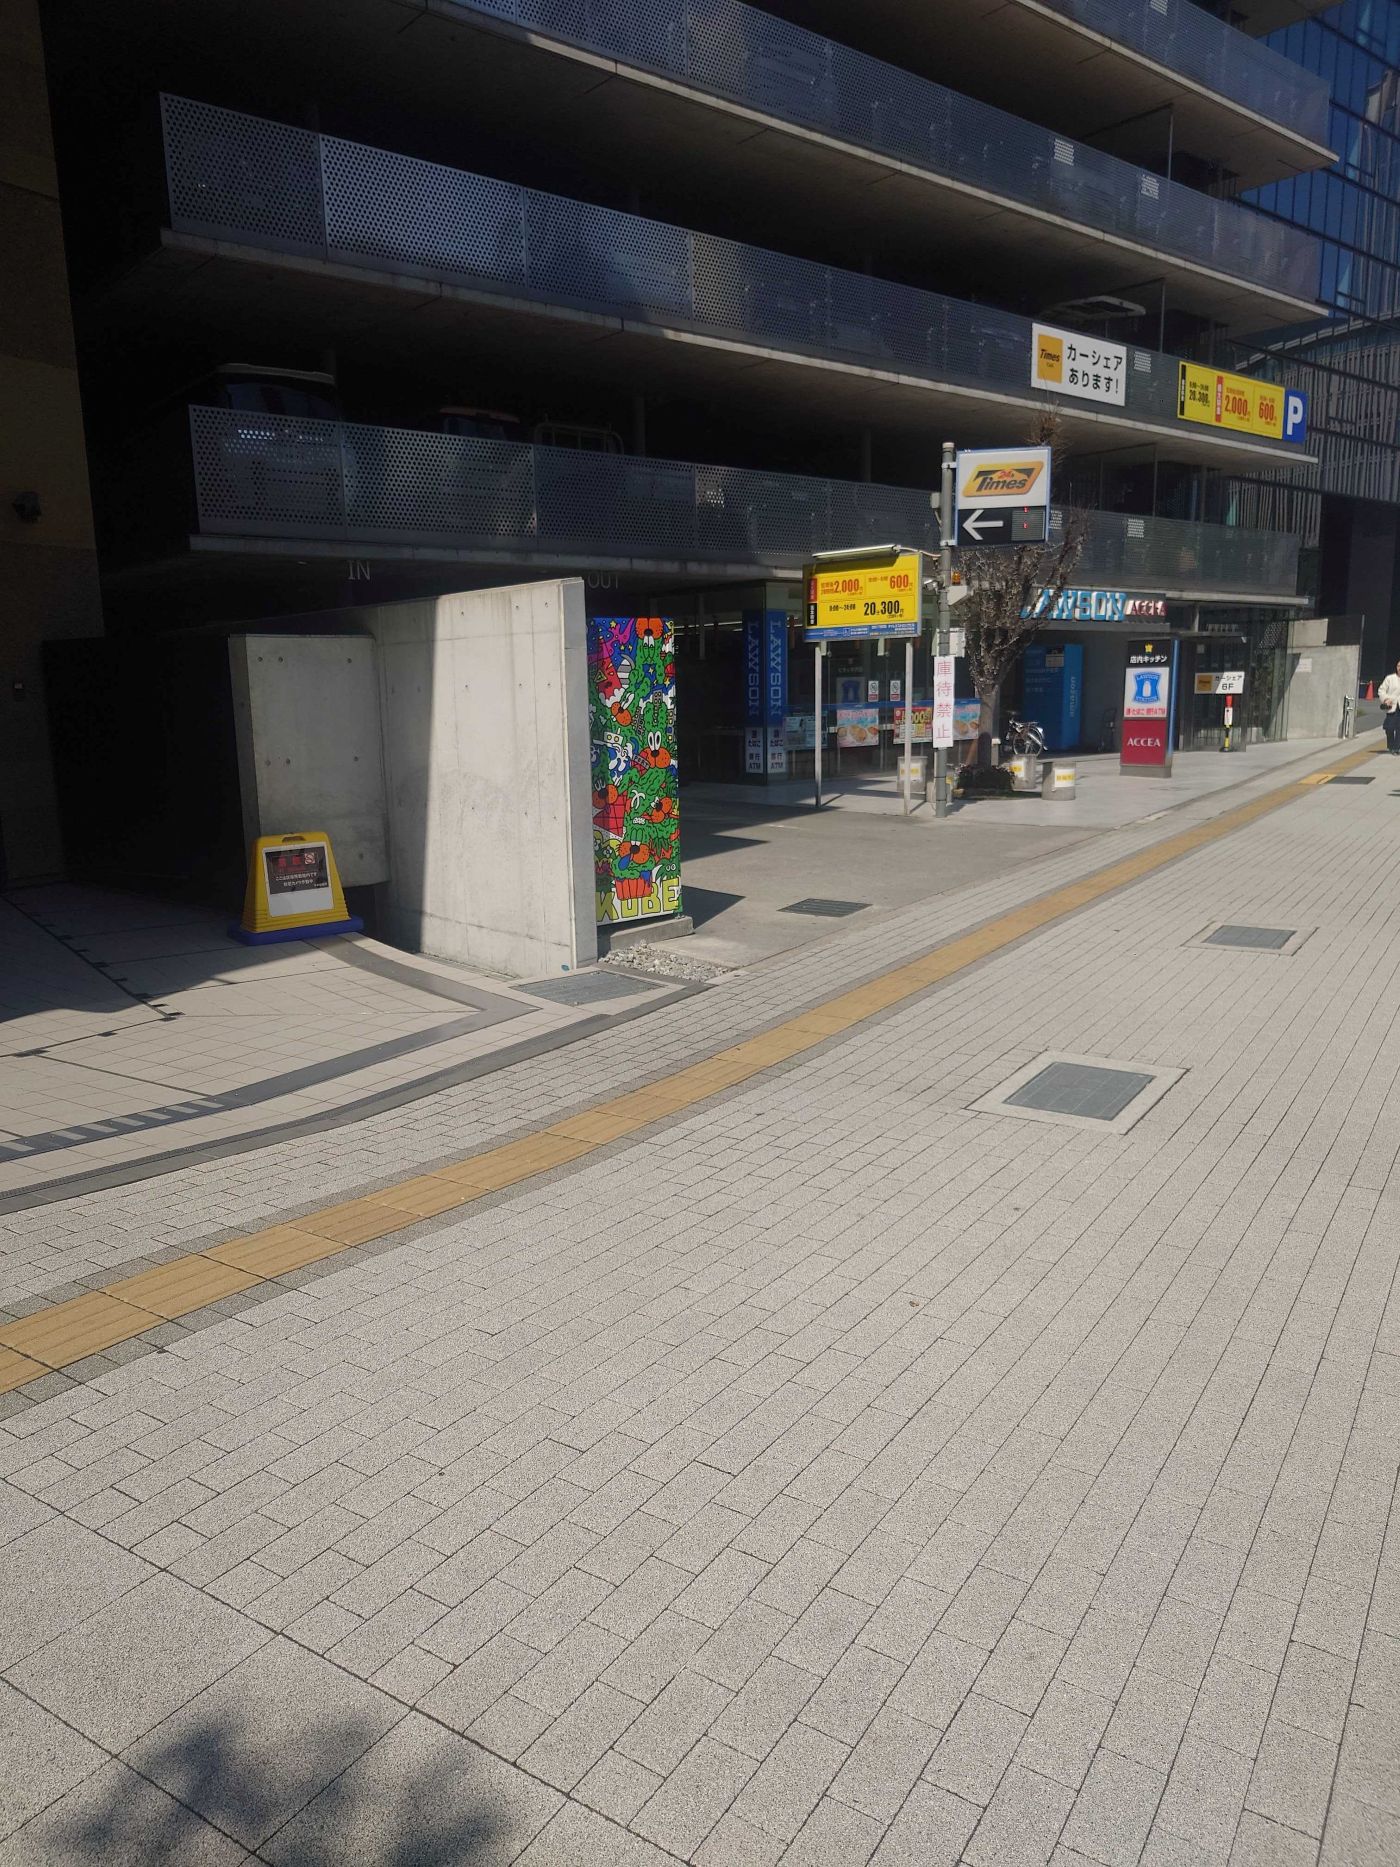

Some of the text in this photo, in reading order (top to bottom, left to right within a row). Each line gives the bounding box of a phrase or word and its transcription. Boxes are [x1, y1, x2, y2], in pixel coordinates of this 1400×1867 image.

[1040, 348, 1060, 362] Times
[1067, 344, 1123, 371] カーシェア
[1286, 395, 1303, 436] P
[974, 475, 1028, 492] Times
[348, 561, 371, 581] IN
[587, 574, 620, 589] OUT
[748, 620, 760, 716] LAWSON
[770, 620, 782, 716] LAWSON
[1222, 683, 1235, 691] 6F
[1127, 737, 1161, 748] ACCEA
